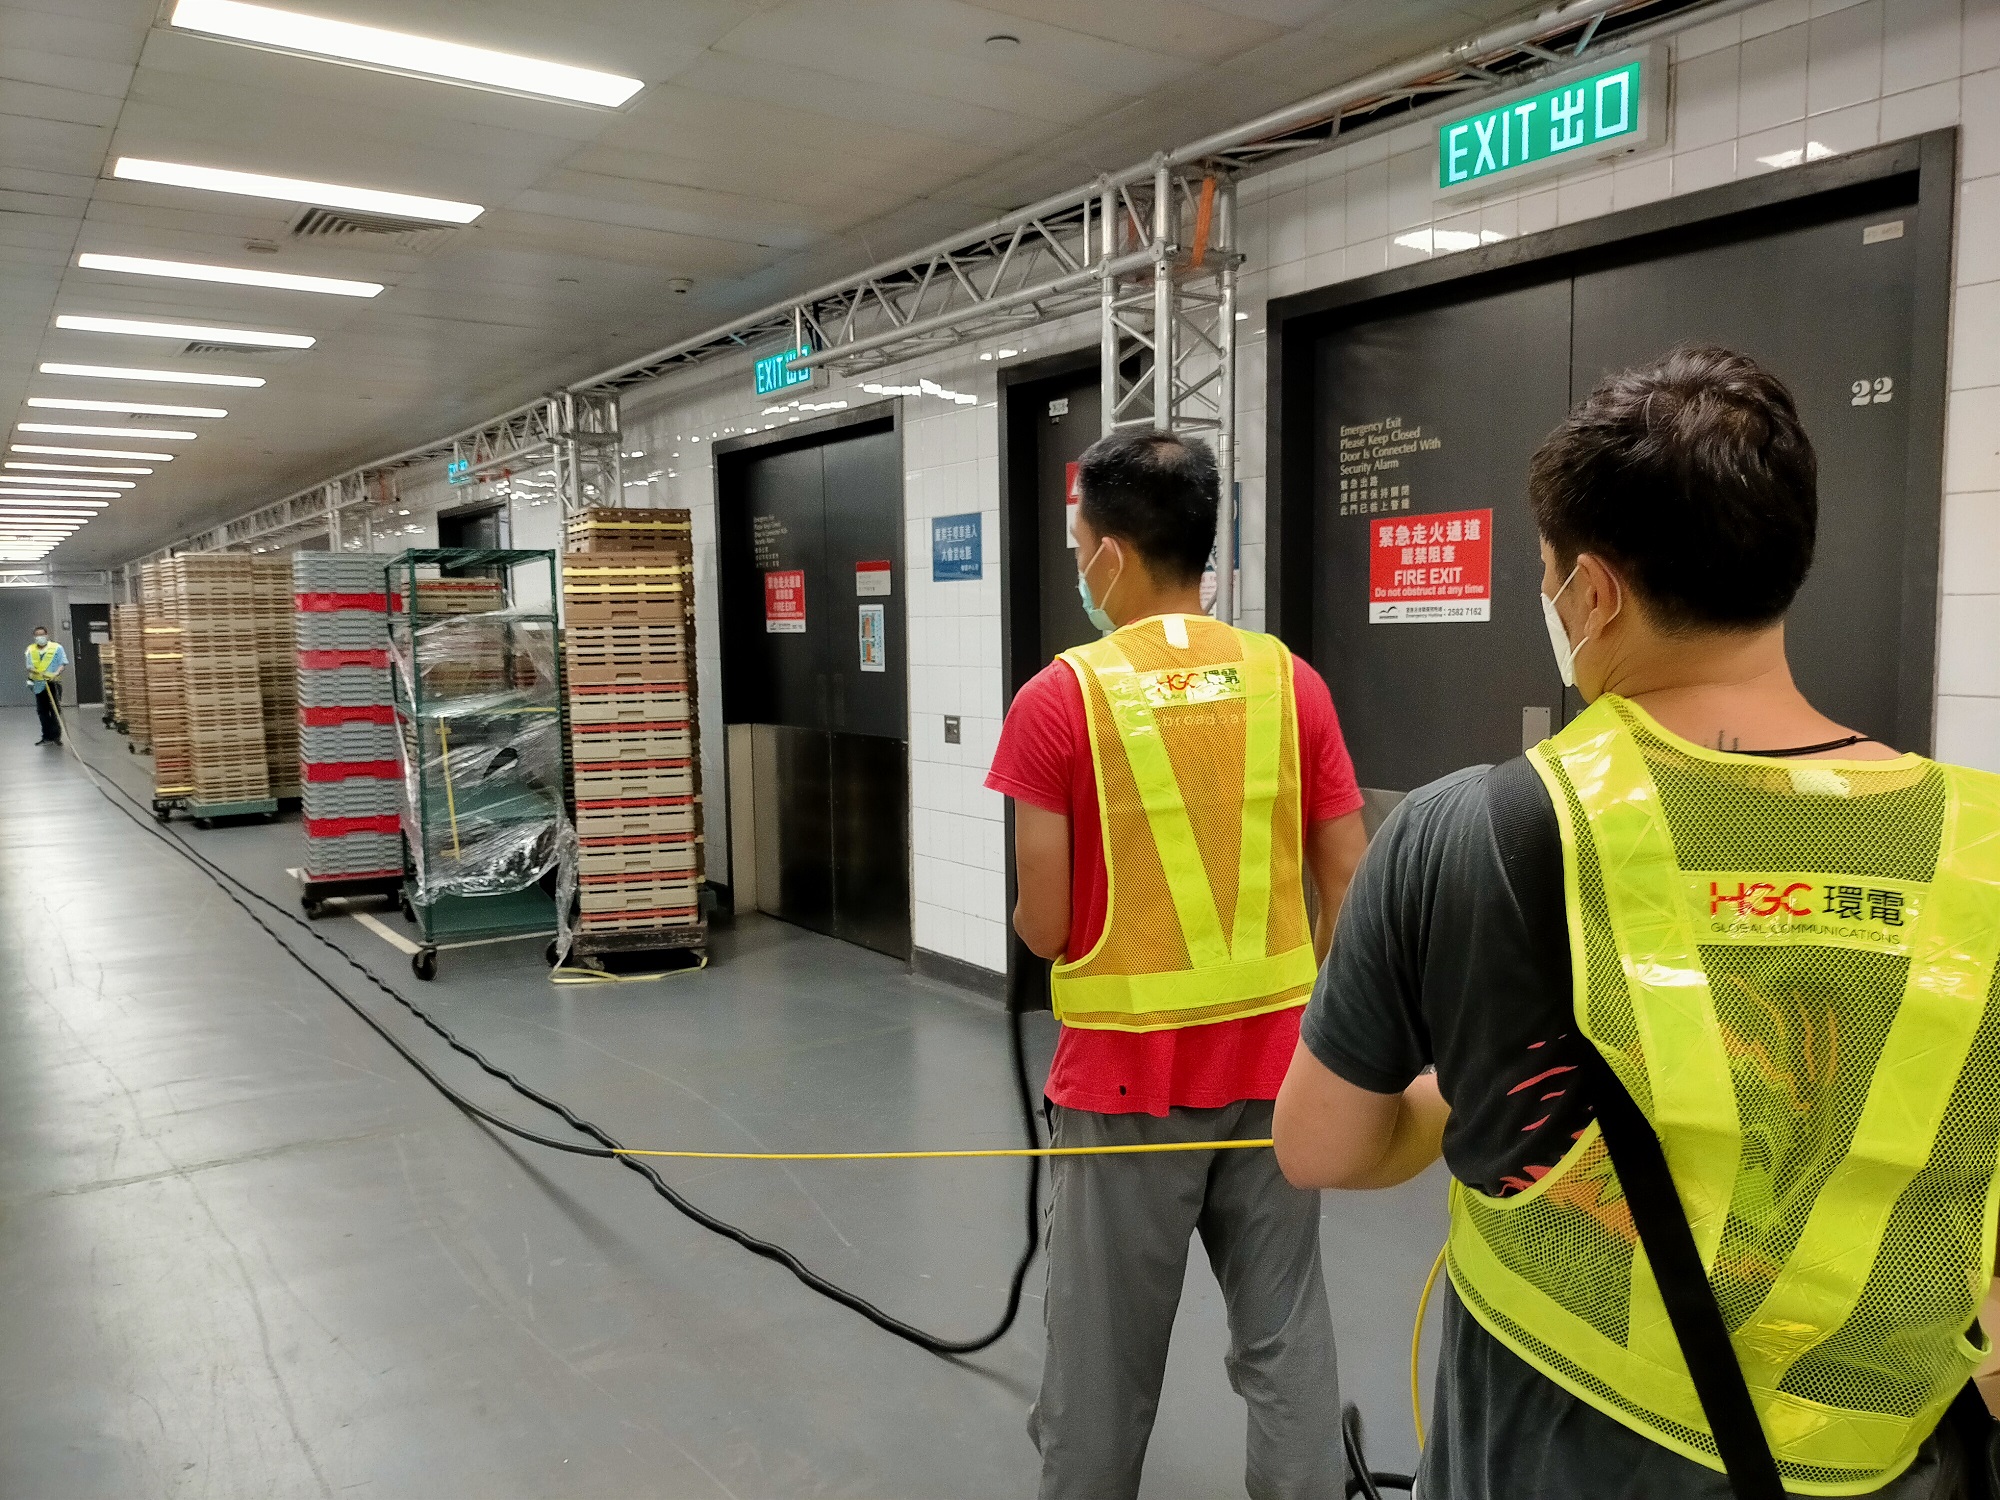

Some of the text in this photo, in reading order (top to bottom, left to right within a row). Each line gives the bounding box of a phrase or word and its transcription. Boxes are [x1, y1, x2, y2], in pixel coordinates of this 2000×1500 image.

[1449, 71, 1629, 182] EXIT 出口
[757, 354, 783, 393] EXIT
[1851, 377, 1893, 406] 22
[1340, 417, 1401, 437] Emergency Exit
[1340, 426, 1420, 450] Please Keep Closed
[1340, 437, 1441, 463] Door Is Connected With
[1340, 459, 1399, 475] Security Alarm
[1379, 519, 1481, 547] 緊急走火通道
[1401, 545, 1455, 565] 嚴禁阻塞
[1394, 566, 1463, 586] FIRE EXIT
[1375, 584, 1484, 597] Do not obstruct at any time
[1447, 608, 1464, 616] 2582
[1710, 882, 1904, 927] HGC 環電
[1710, 922, 1900, 945] GLOBAL COMMUNICATIONS
